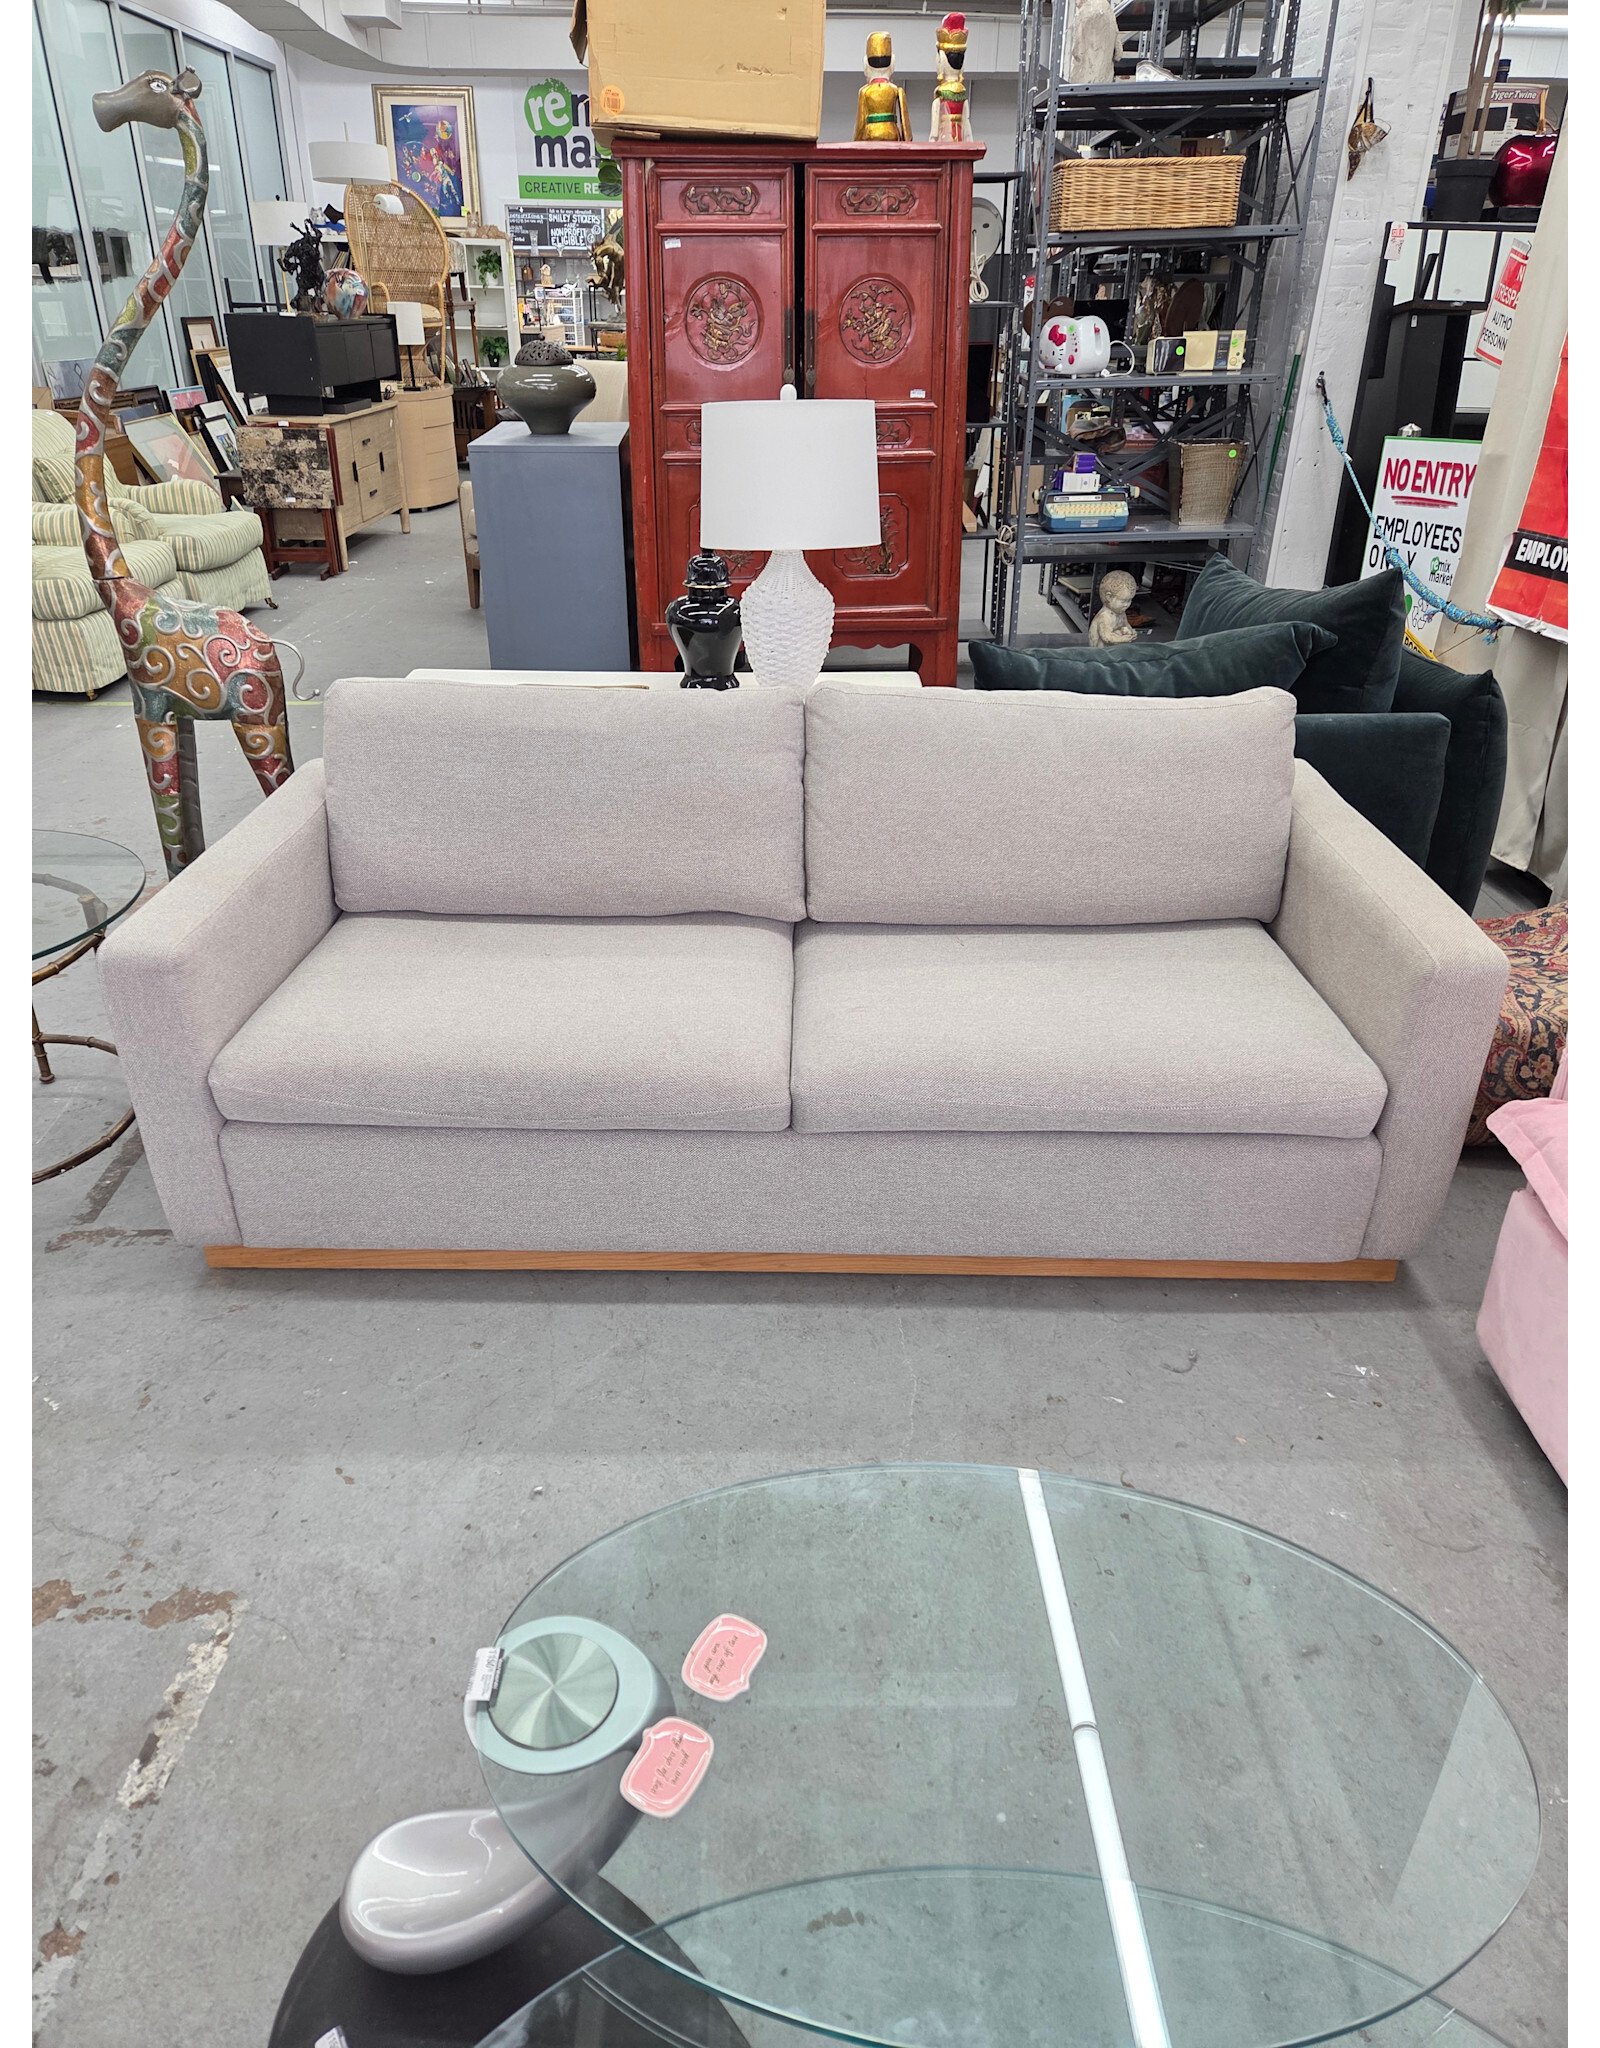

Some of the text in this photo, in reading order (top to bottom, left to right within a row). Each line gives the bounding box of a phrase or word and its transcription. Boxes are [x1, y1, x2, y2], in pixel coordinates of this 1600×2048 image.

[1490, 89, 1537, 100] Tyger Twine
[524, 181, 581, 194] CREATIVE
[548, 213, 570, 223] SMILEY
[551, 236, 586, 246] ELIGIBLE
[1492, 310, 1513, 331] AUTHO
[1482, 328, 1509, 352] PERSONN
[1383, 457, 1478, 499] NO ENTRY
[1373, 515, 1462, 554] EMPLOYEES
[1429, 571, 1453, 587] market
